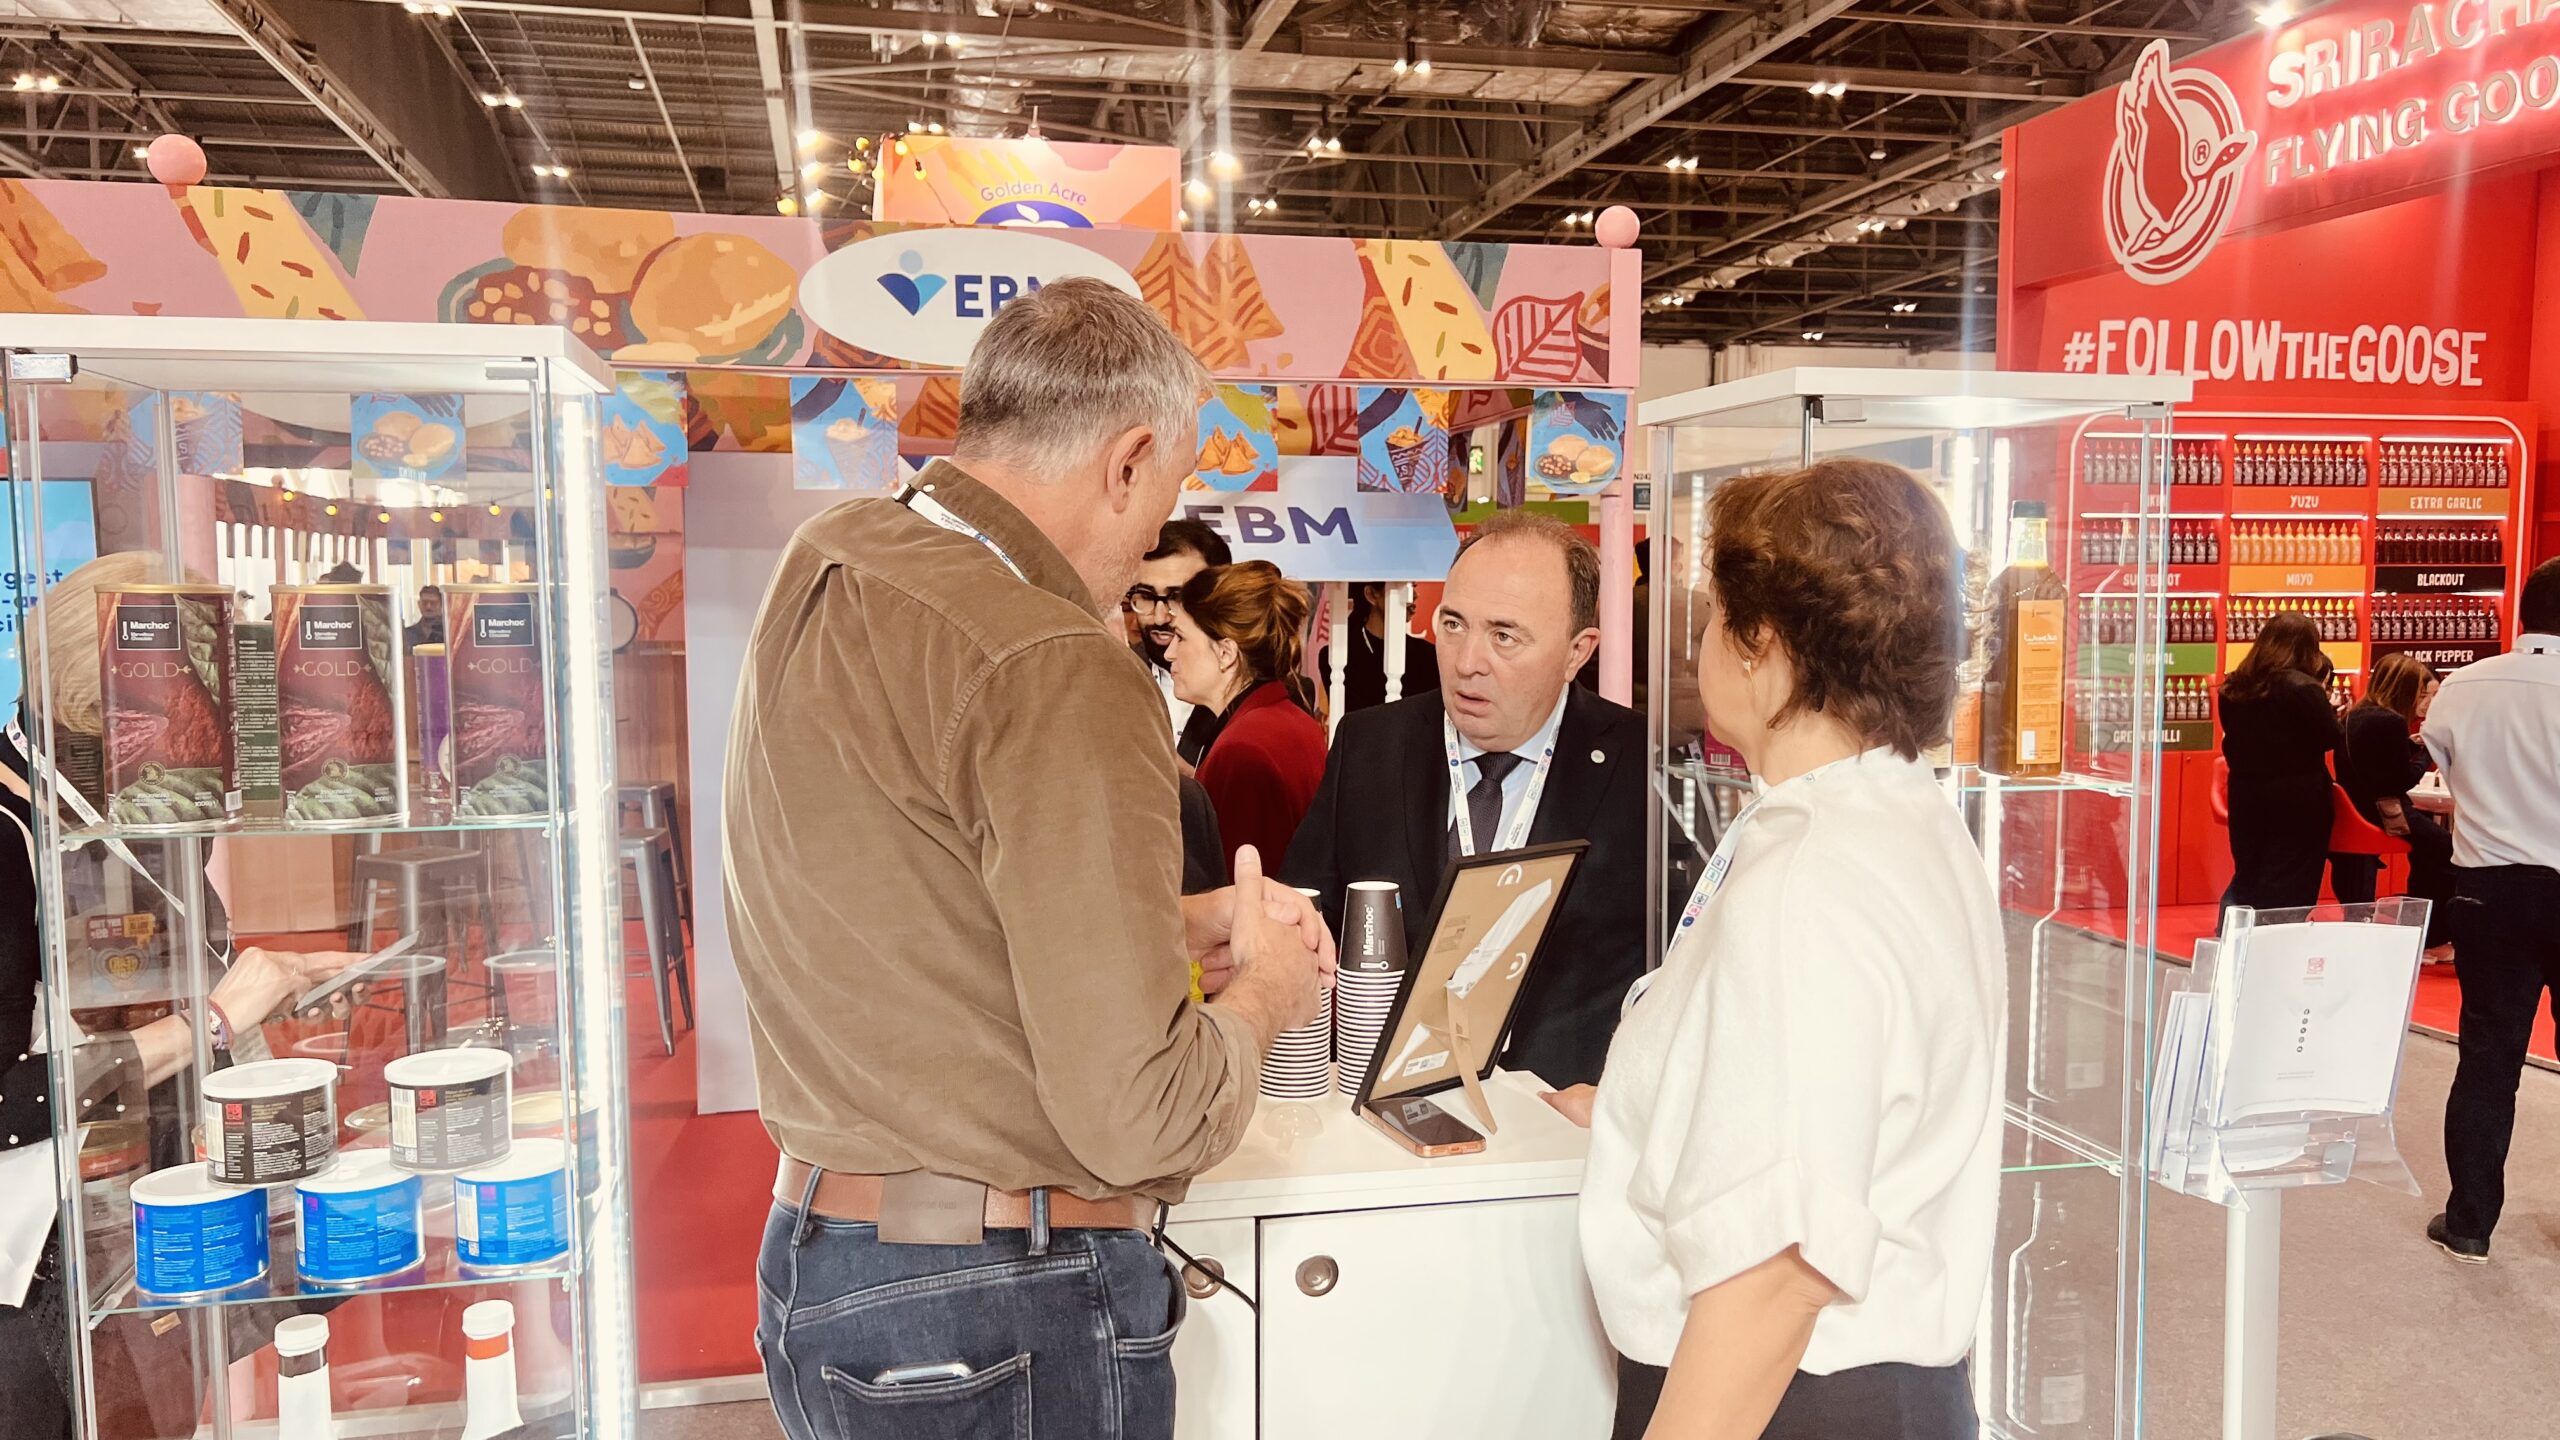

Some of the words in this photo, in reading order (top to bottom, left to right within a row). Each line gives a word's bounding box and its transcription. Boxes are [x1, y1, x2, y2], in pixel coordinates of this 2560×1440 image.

[2265, 99, 2426, 186] FLYING
[981, 180, 1043, 202] Golden
[1048, 183, 1087, 206] Acre
[2063, 317, 2487, 386] #FOLLOWTHEGOOSE
[2290, 495, 2319, 508] YUZU
[2410, 497, 2442, 509] EXTRA
[2447, 497, 2482, 509] GARLIC
[2286, 573, 2313, 586] MAYO
[2417, 573, 2465, 586] BLACKOUT
[130, 621, 170, 629] Marchoc
[314, 621, 352, 629] Marchoc
[488, 618, 524, 626] Marchoc
[2435, 650, 2474, 663] PEPPER
[119, 663, 179, 677] GOLD
[302, 660, 361, 676] GOLD
[476, 657, 533, 673] GOLD
[1363, 905, 1374, 956] Marchoc
